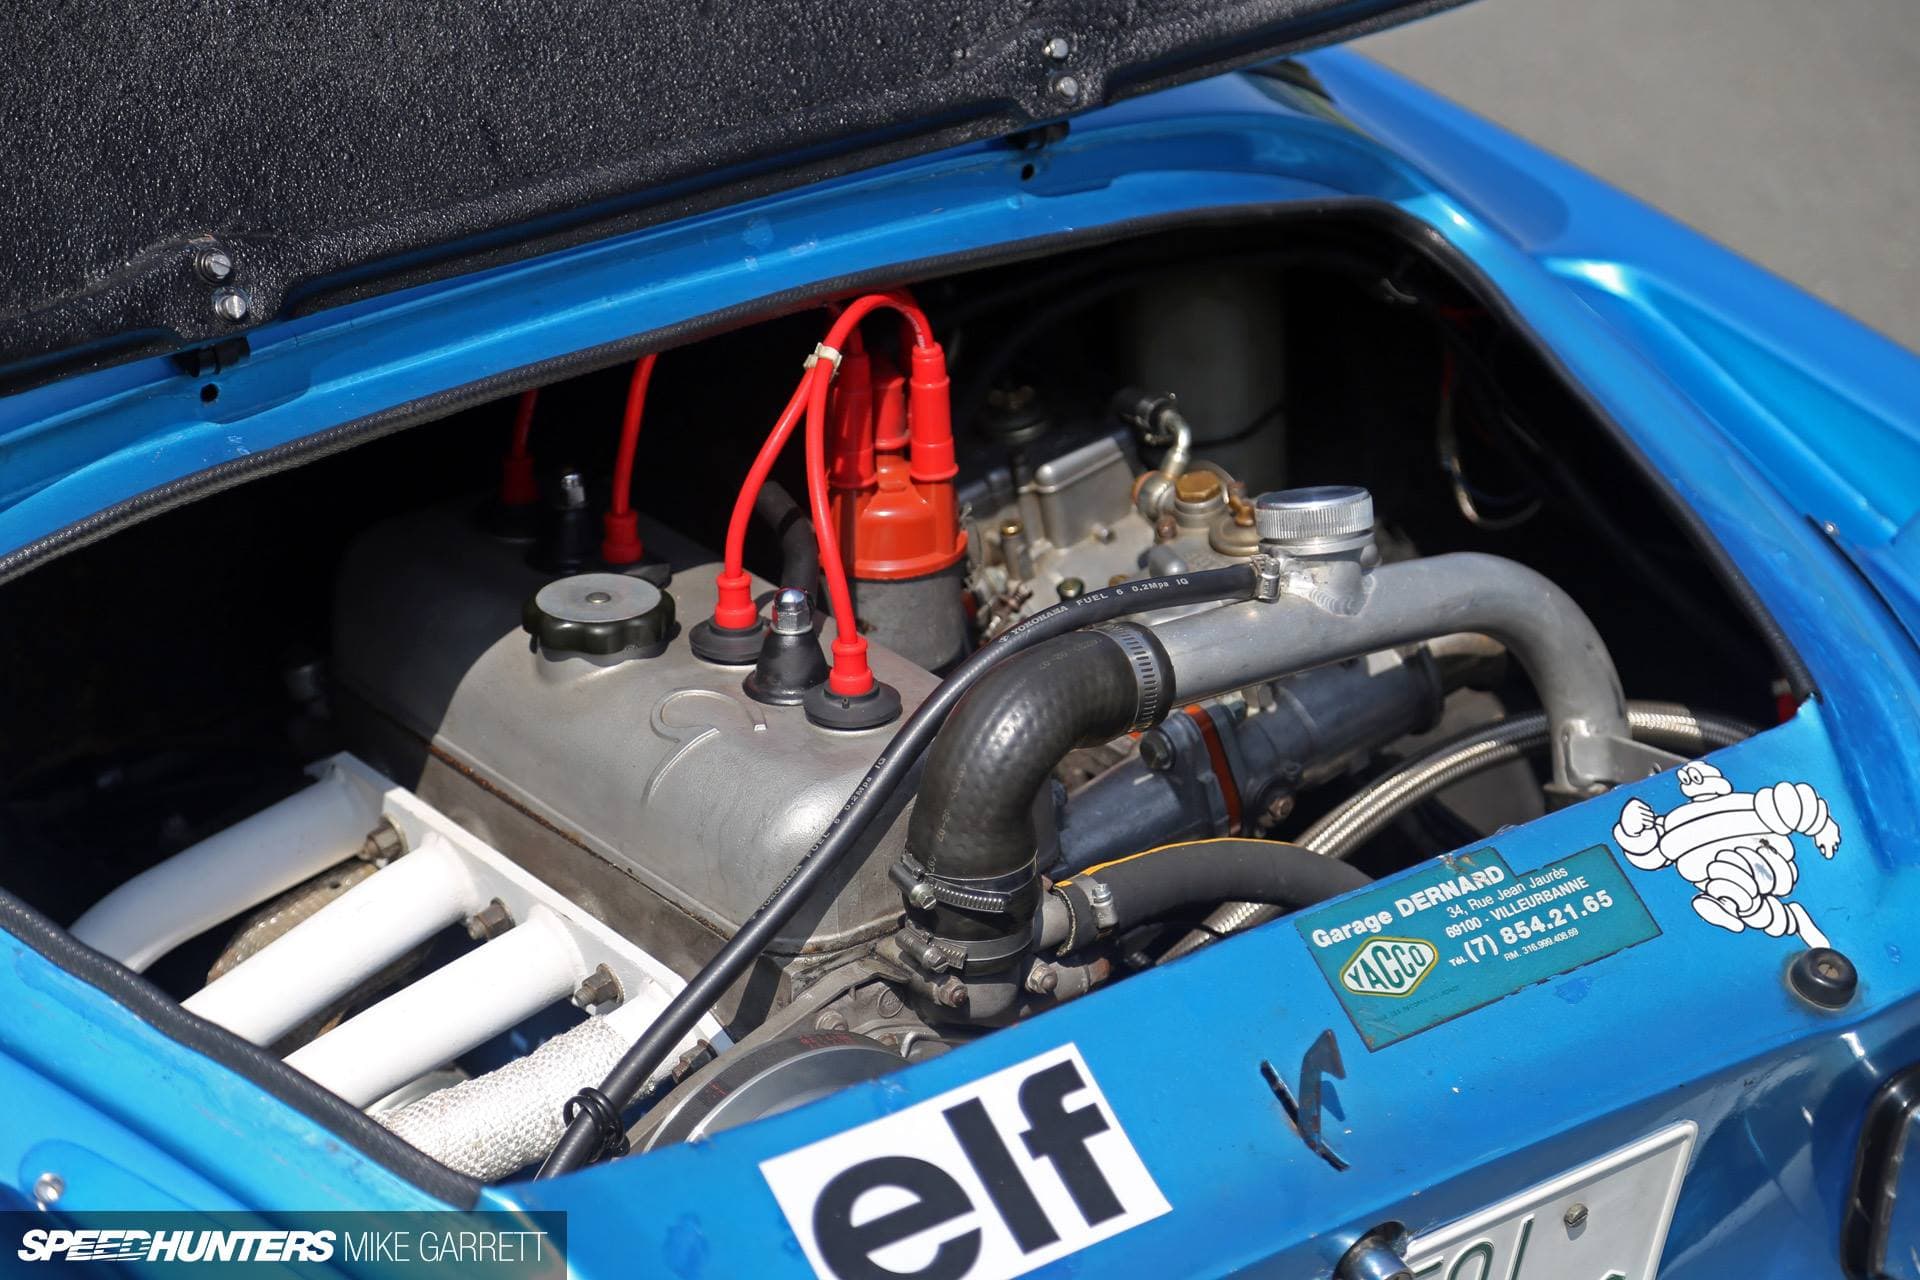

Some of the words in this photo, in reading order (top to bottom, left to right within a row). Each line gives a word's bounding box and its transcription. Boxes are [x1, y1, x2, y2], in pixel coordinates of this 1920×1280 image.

[1011, 605, 1069, 636] YOKOHAMA
[1075, 592, 1109, 607] FUEL
[1115, 588, 1124, 596] 6
[1131, 581, 1169, 593] 0.2Mpa
[806, 832, 830, 858] FUEL
[1312, 910, 1393, 948] Garage
[1395, 865, 1505, 917] DERNARD
[1445, 916, 1482, 939] 69100
[1490, 876, 1590, 921] VILLEURBANNE
[1446, 903, 1468, 919] 34,
[1467, 895, 1494, 911] Rue
[1498, 882, 1526, 901] Jean
[1529, 866, 1569, 889] Jaurès
[1463, 934, 1499, 963] (7)
[1500, 889, 1614, 945] 854.21.65
[1348, 944, 1427, 990] YACCO
[812, 1057, 1128, 1280] elf
